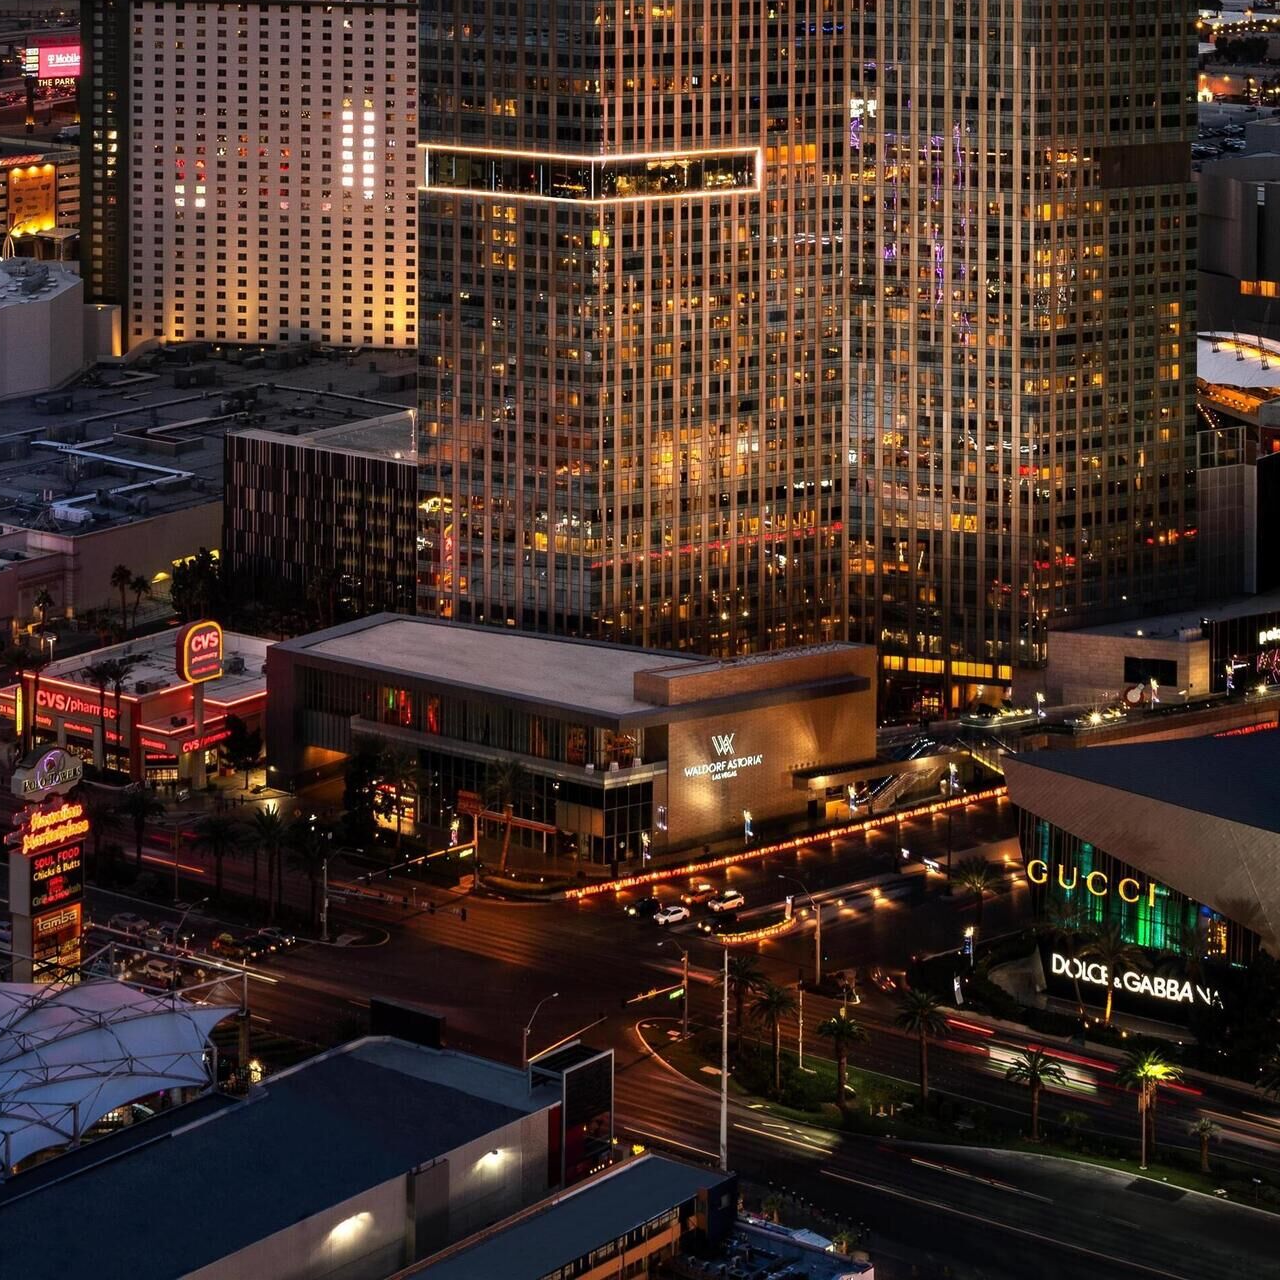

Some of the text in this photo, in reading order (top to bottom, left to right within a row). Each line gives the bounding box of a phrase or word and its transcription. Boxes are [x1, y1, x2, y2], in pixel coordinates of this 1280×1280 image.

[55, 53, 80, 63] Mobile
[38, 77, 75, 87] THE PARK
[191, 631, 219, 652] CVS
[191, 652, 218, 664] pharmacy
[36, 690, 121, 719] CVS/pharmac
[684, 761, 727, 777] WALDORF
[712, 770, 737, 781] LAS VEGAS
[22, 820, 89, 854] Marketplace
[34, 847, 79, 870] SOUL FOOD
[33, 860, 81, 881] Chicks & Butts
[1027, 859, 1156, 907] GUCCI
[37, 909, 77, 931] tamba
[1052, 953, 1109, 986] DOLCE
[1113, 977, 1122, 988] &
